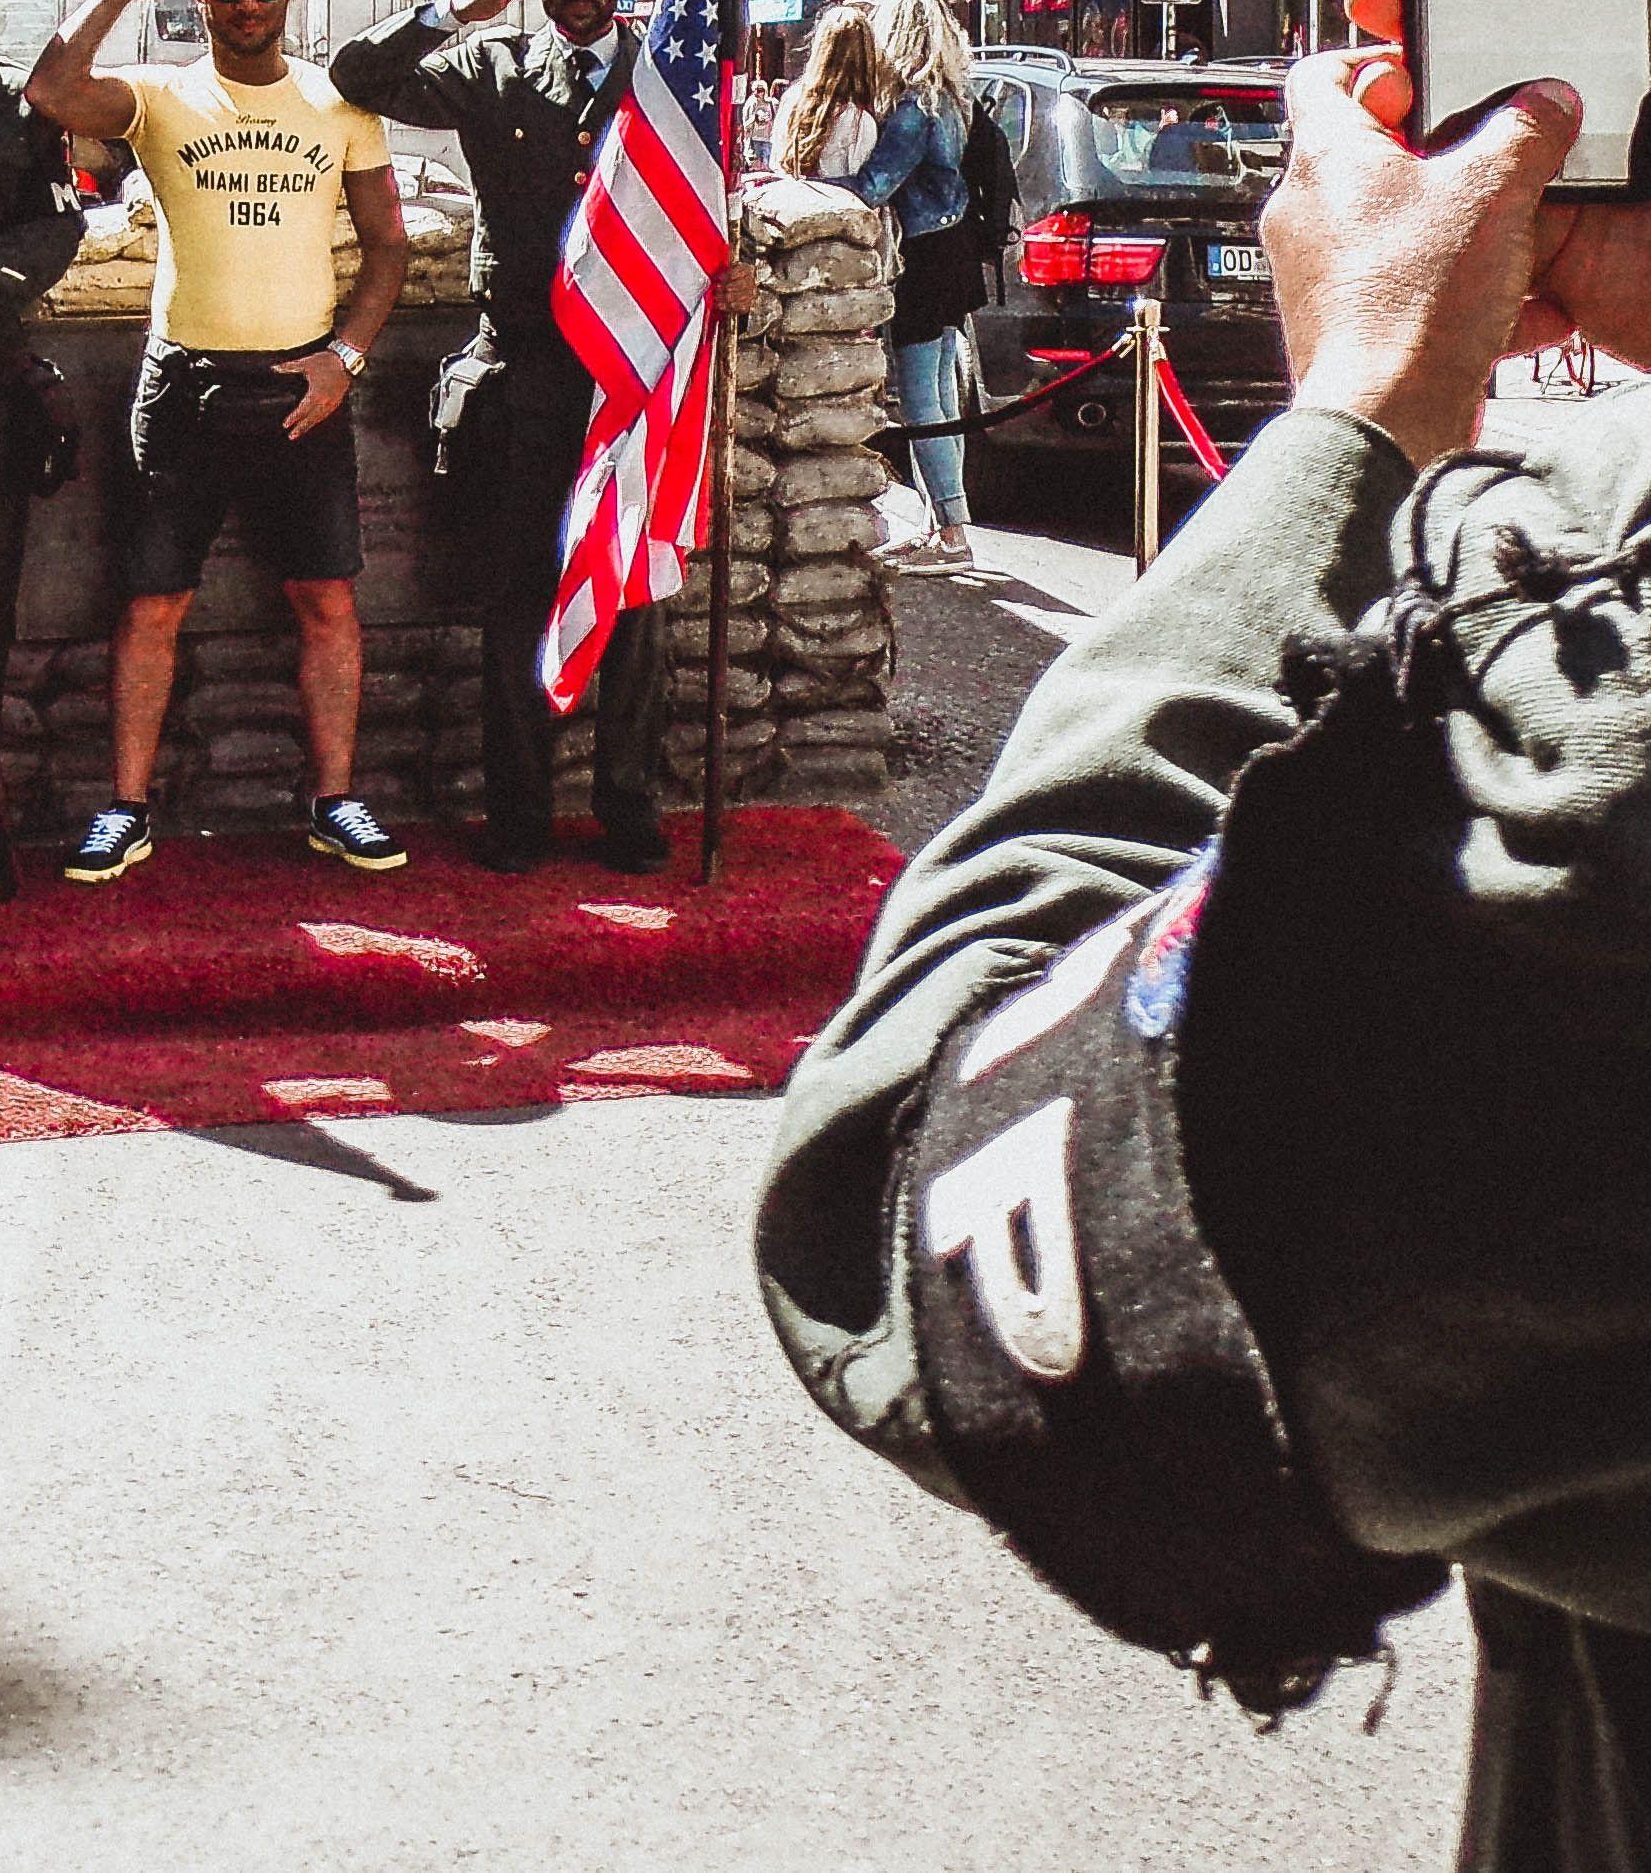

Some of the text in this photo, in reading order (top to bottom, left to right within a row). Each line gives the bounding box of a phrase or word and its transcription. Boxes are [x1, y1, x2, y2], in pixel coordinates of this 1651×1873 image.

[176, 129, 335, 175] MUHAMMAD ALI
[196, 169, 316, 193] MIAMI BEACH
[229, 200, 281, 226] 1964
